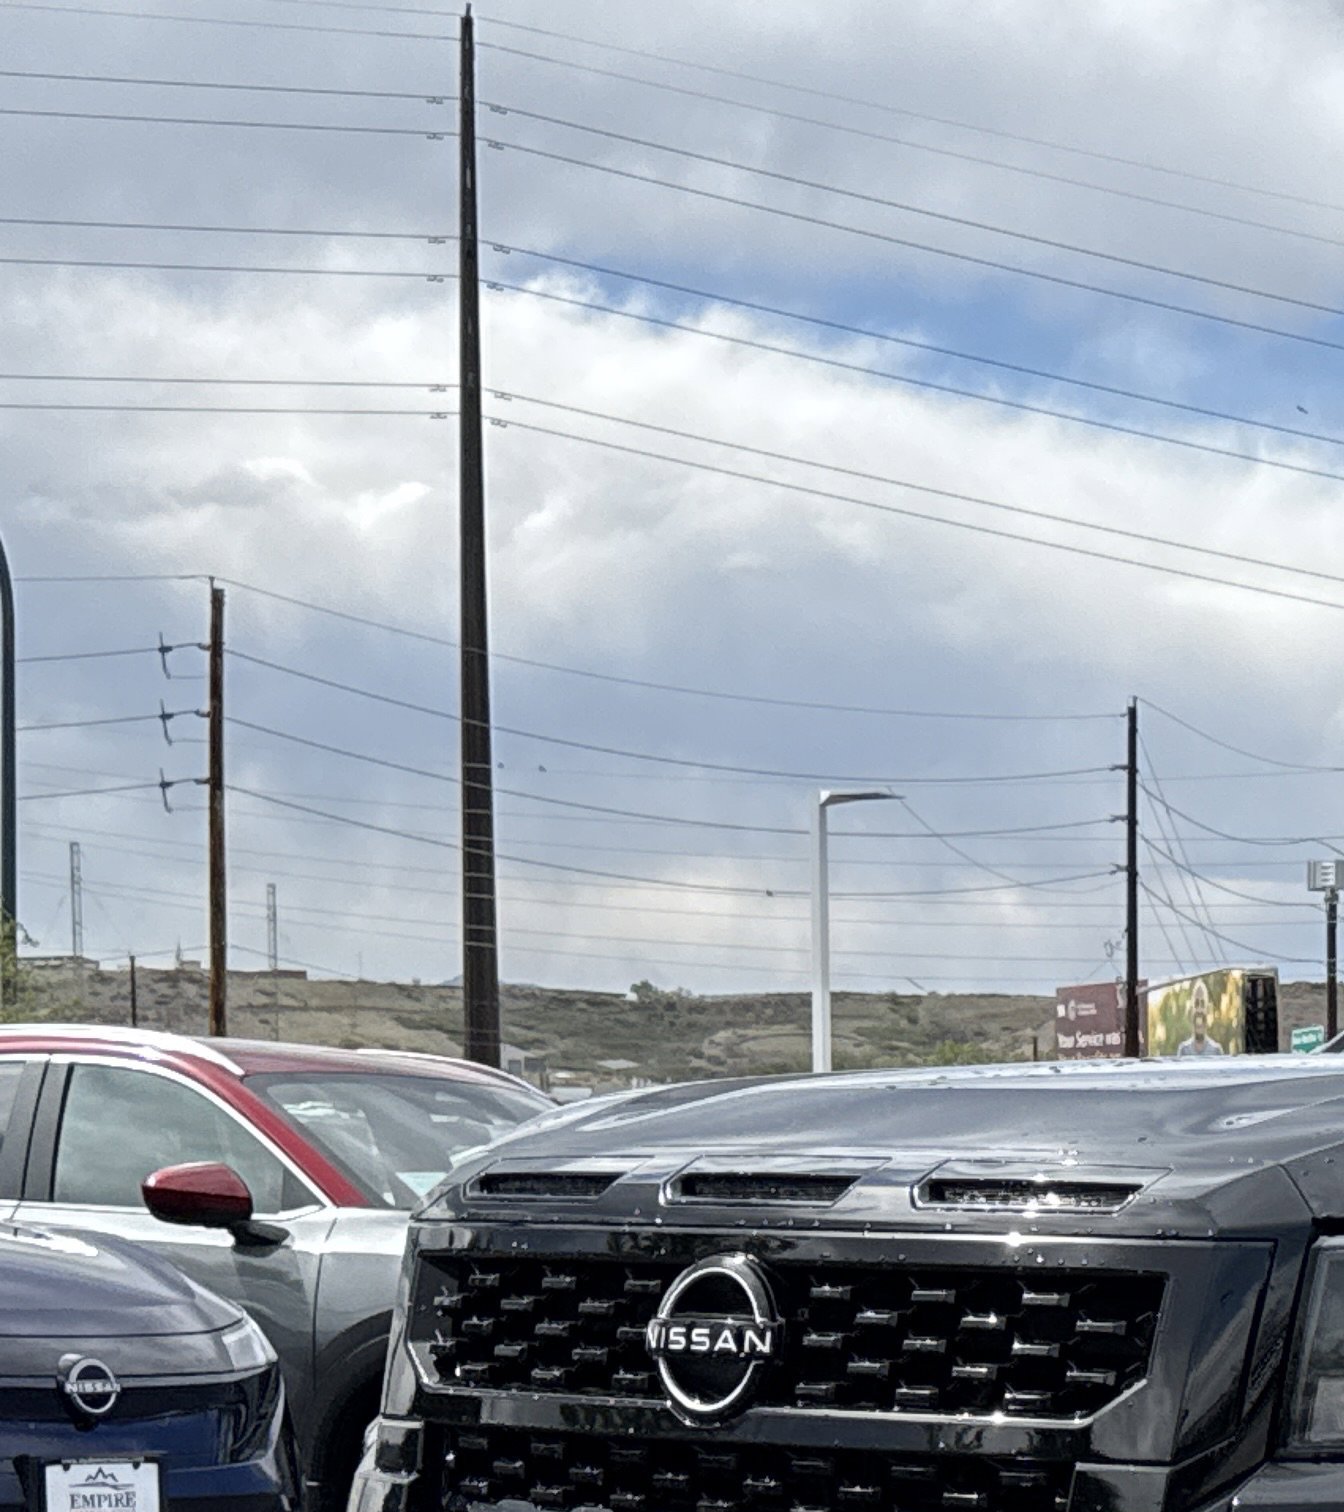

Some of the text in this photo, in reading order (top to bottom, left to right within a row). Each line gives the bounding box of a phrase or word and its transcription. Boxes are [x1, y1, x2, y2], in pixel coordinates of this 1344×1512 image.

[648, 1325, 772, 1354] NISSAN
[65, 1382, 121, 1394] NISSAN
[69, 1491, 137, 1510] EMPIRE
